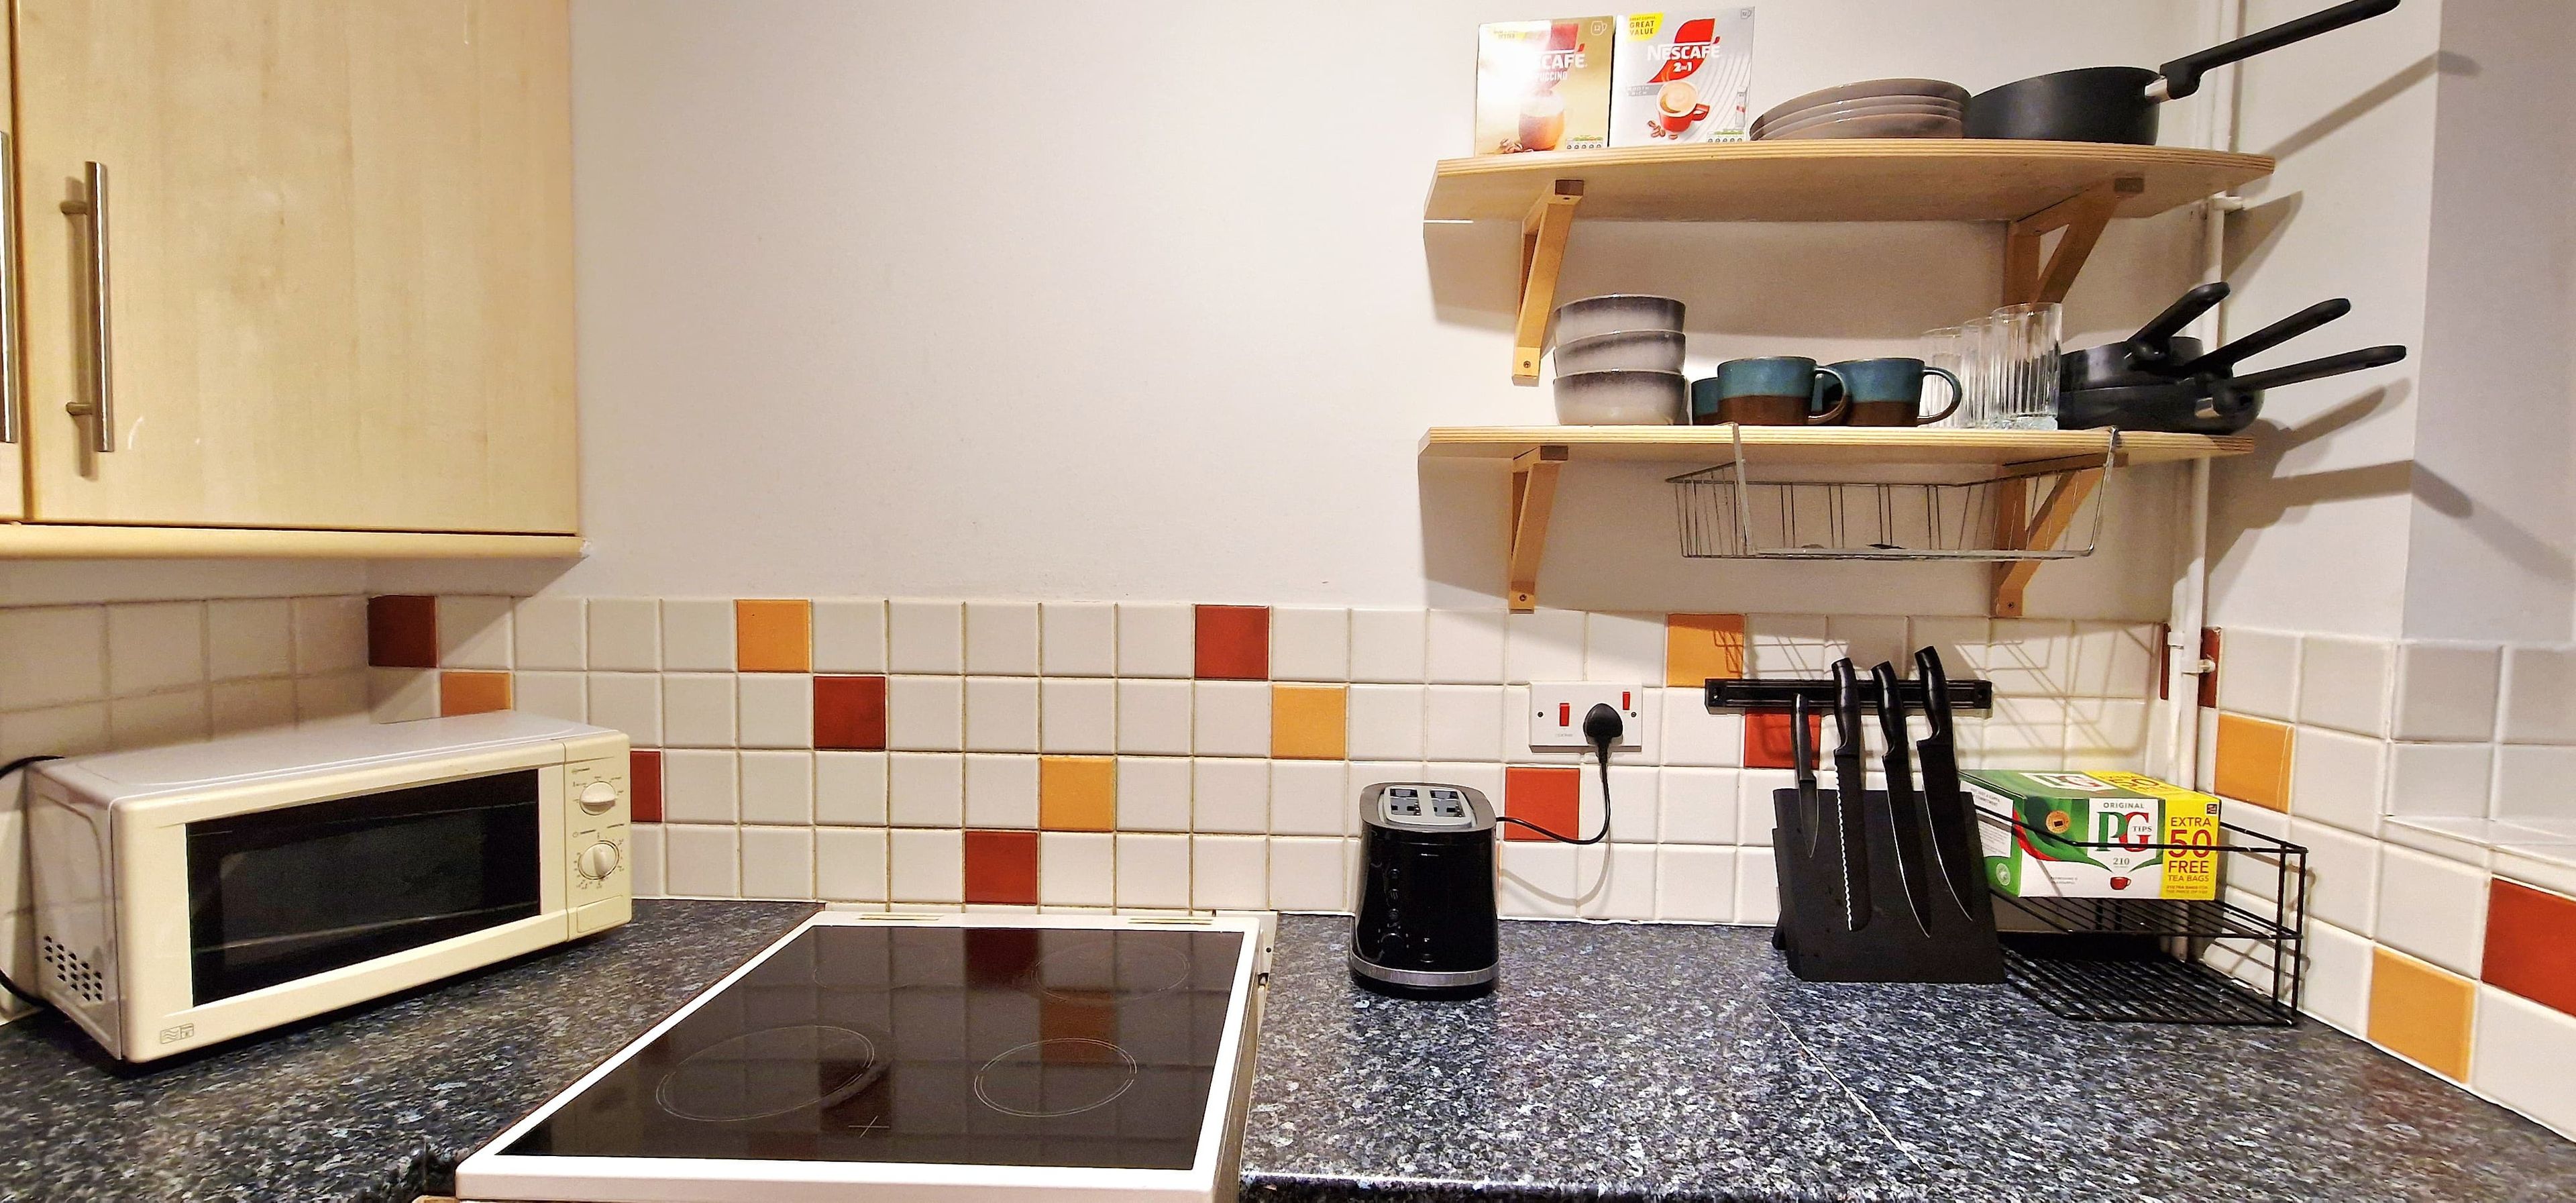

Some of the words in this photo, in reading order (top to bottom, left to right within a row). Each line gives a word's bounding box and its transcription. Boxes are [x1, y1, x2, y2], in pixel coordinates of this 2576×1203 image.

[1629, 20, 1654, 28] GREAT
[2170, 817, 2212, 827] EXTRA
[2094, 811, 2149, 852] PG
[2168, 829, 2212, 858] 50
[2168, 860, 2209, 874] FREE
